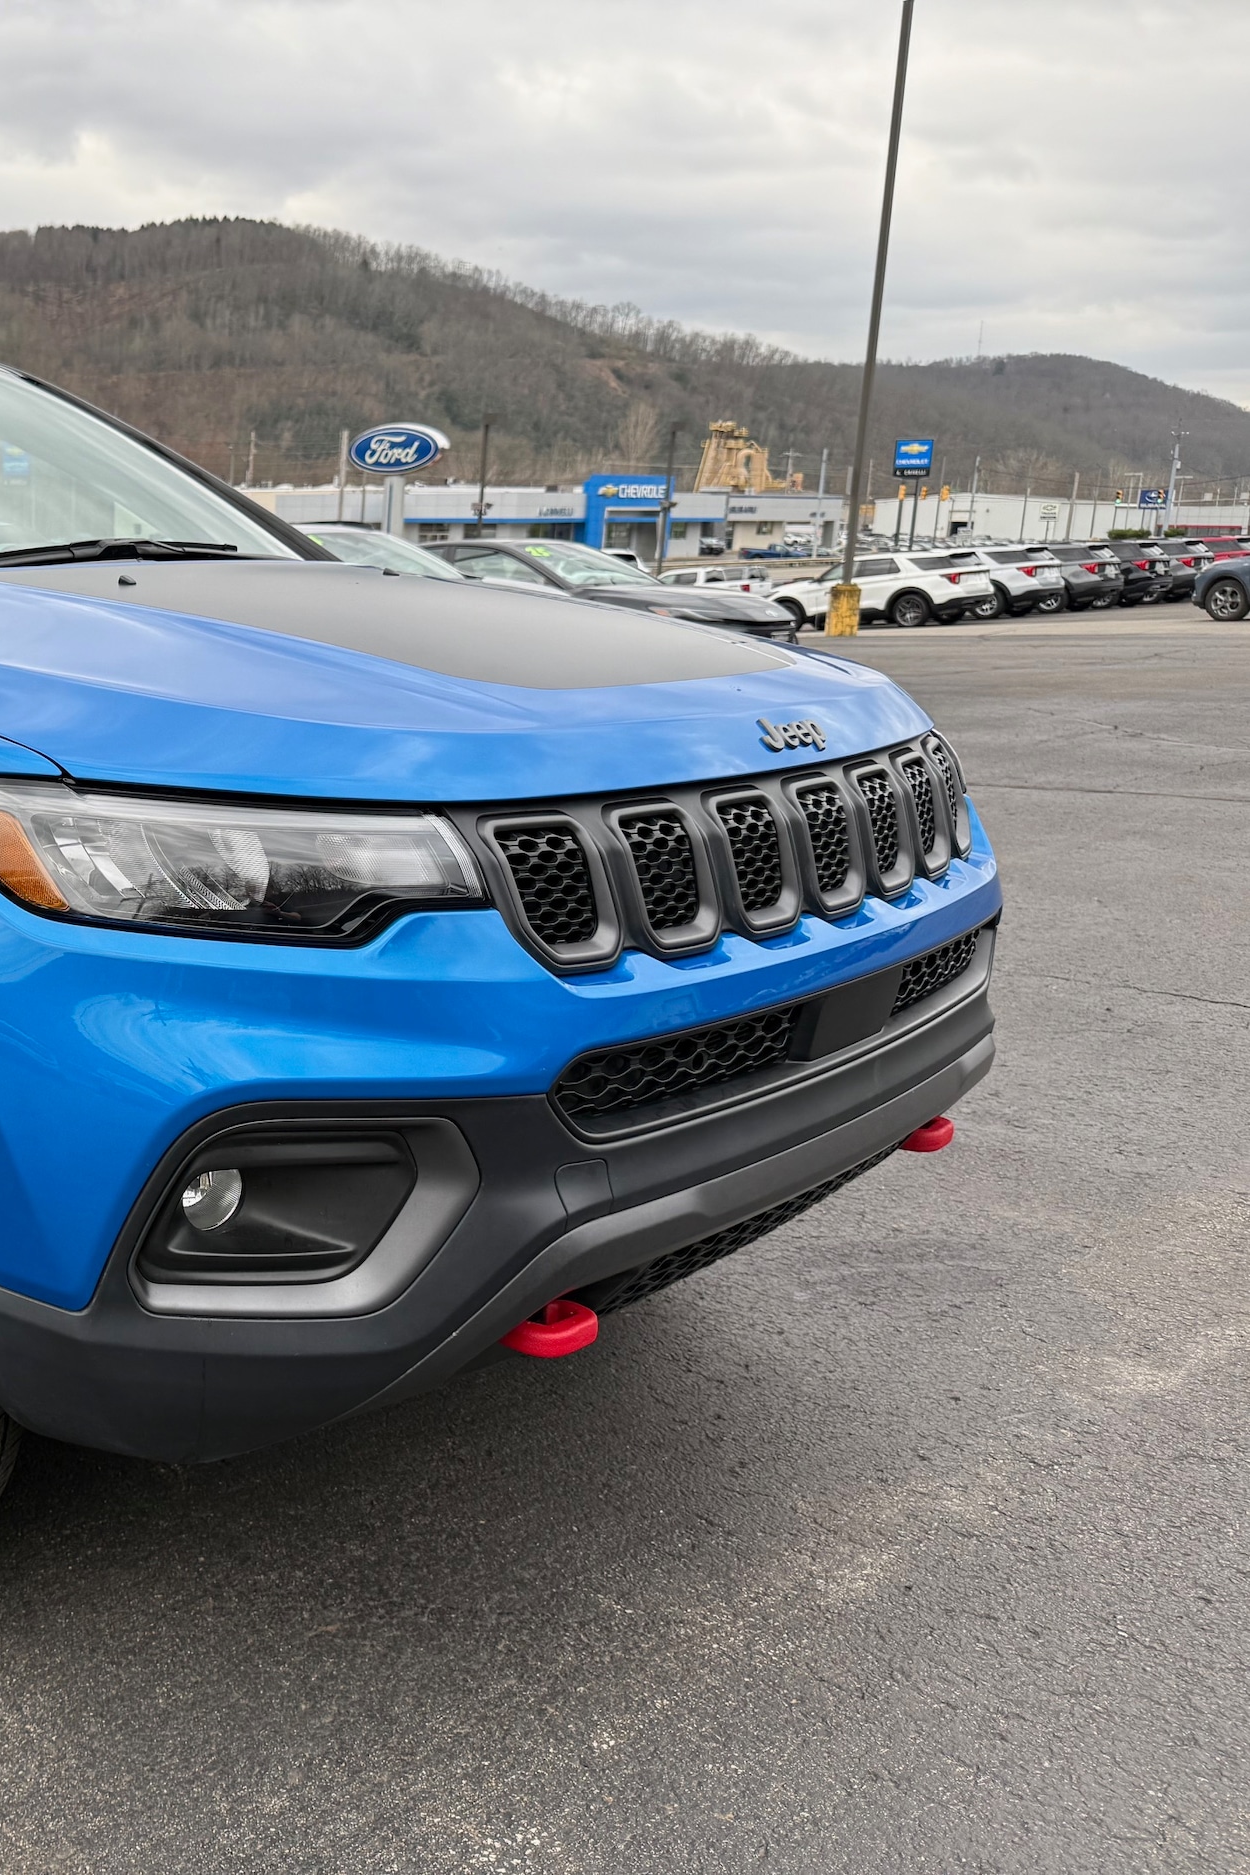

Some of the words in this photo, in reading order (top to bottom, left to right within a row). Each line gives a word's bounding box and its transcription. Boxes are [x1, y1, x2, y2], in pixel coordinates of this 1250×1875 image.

[365, 434, 420, 465] Ford
[618, 484, 667, 498] CHEVROLE
[756, 718, 826, 753] Jeep
